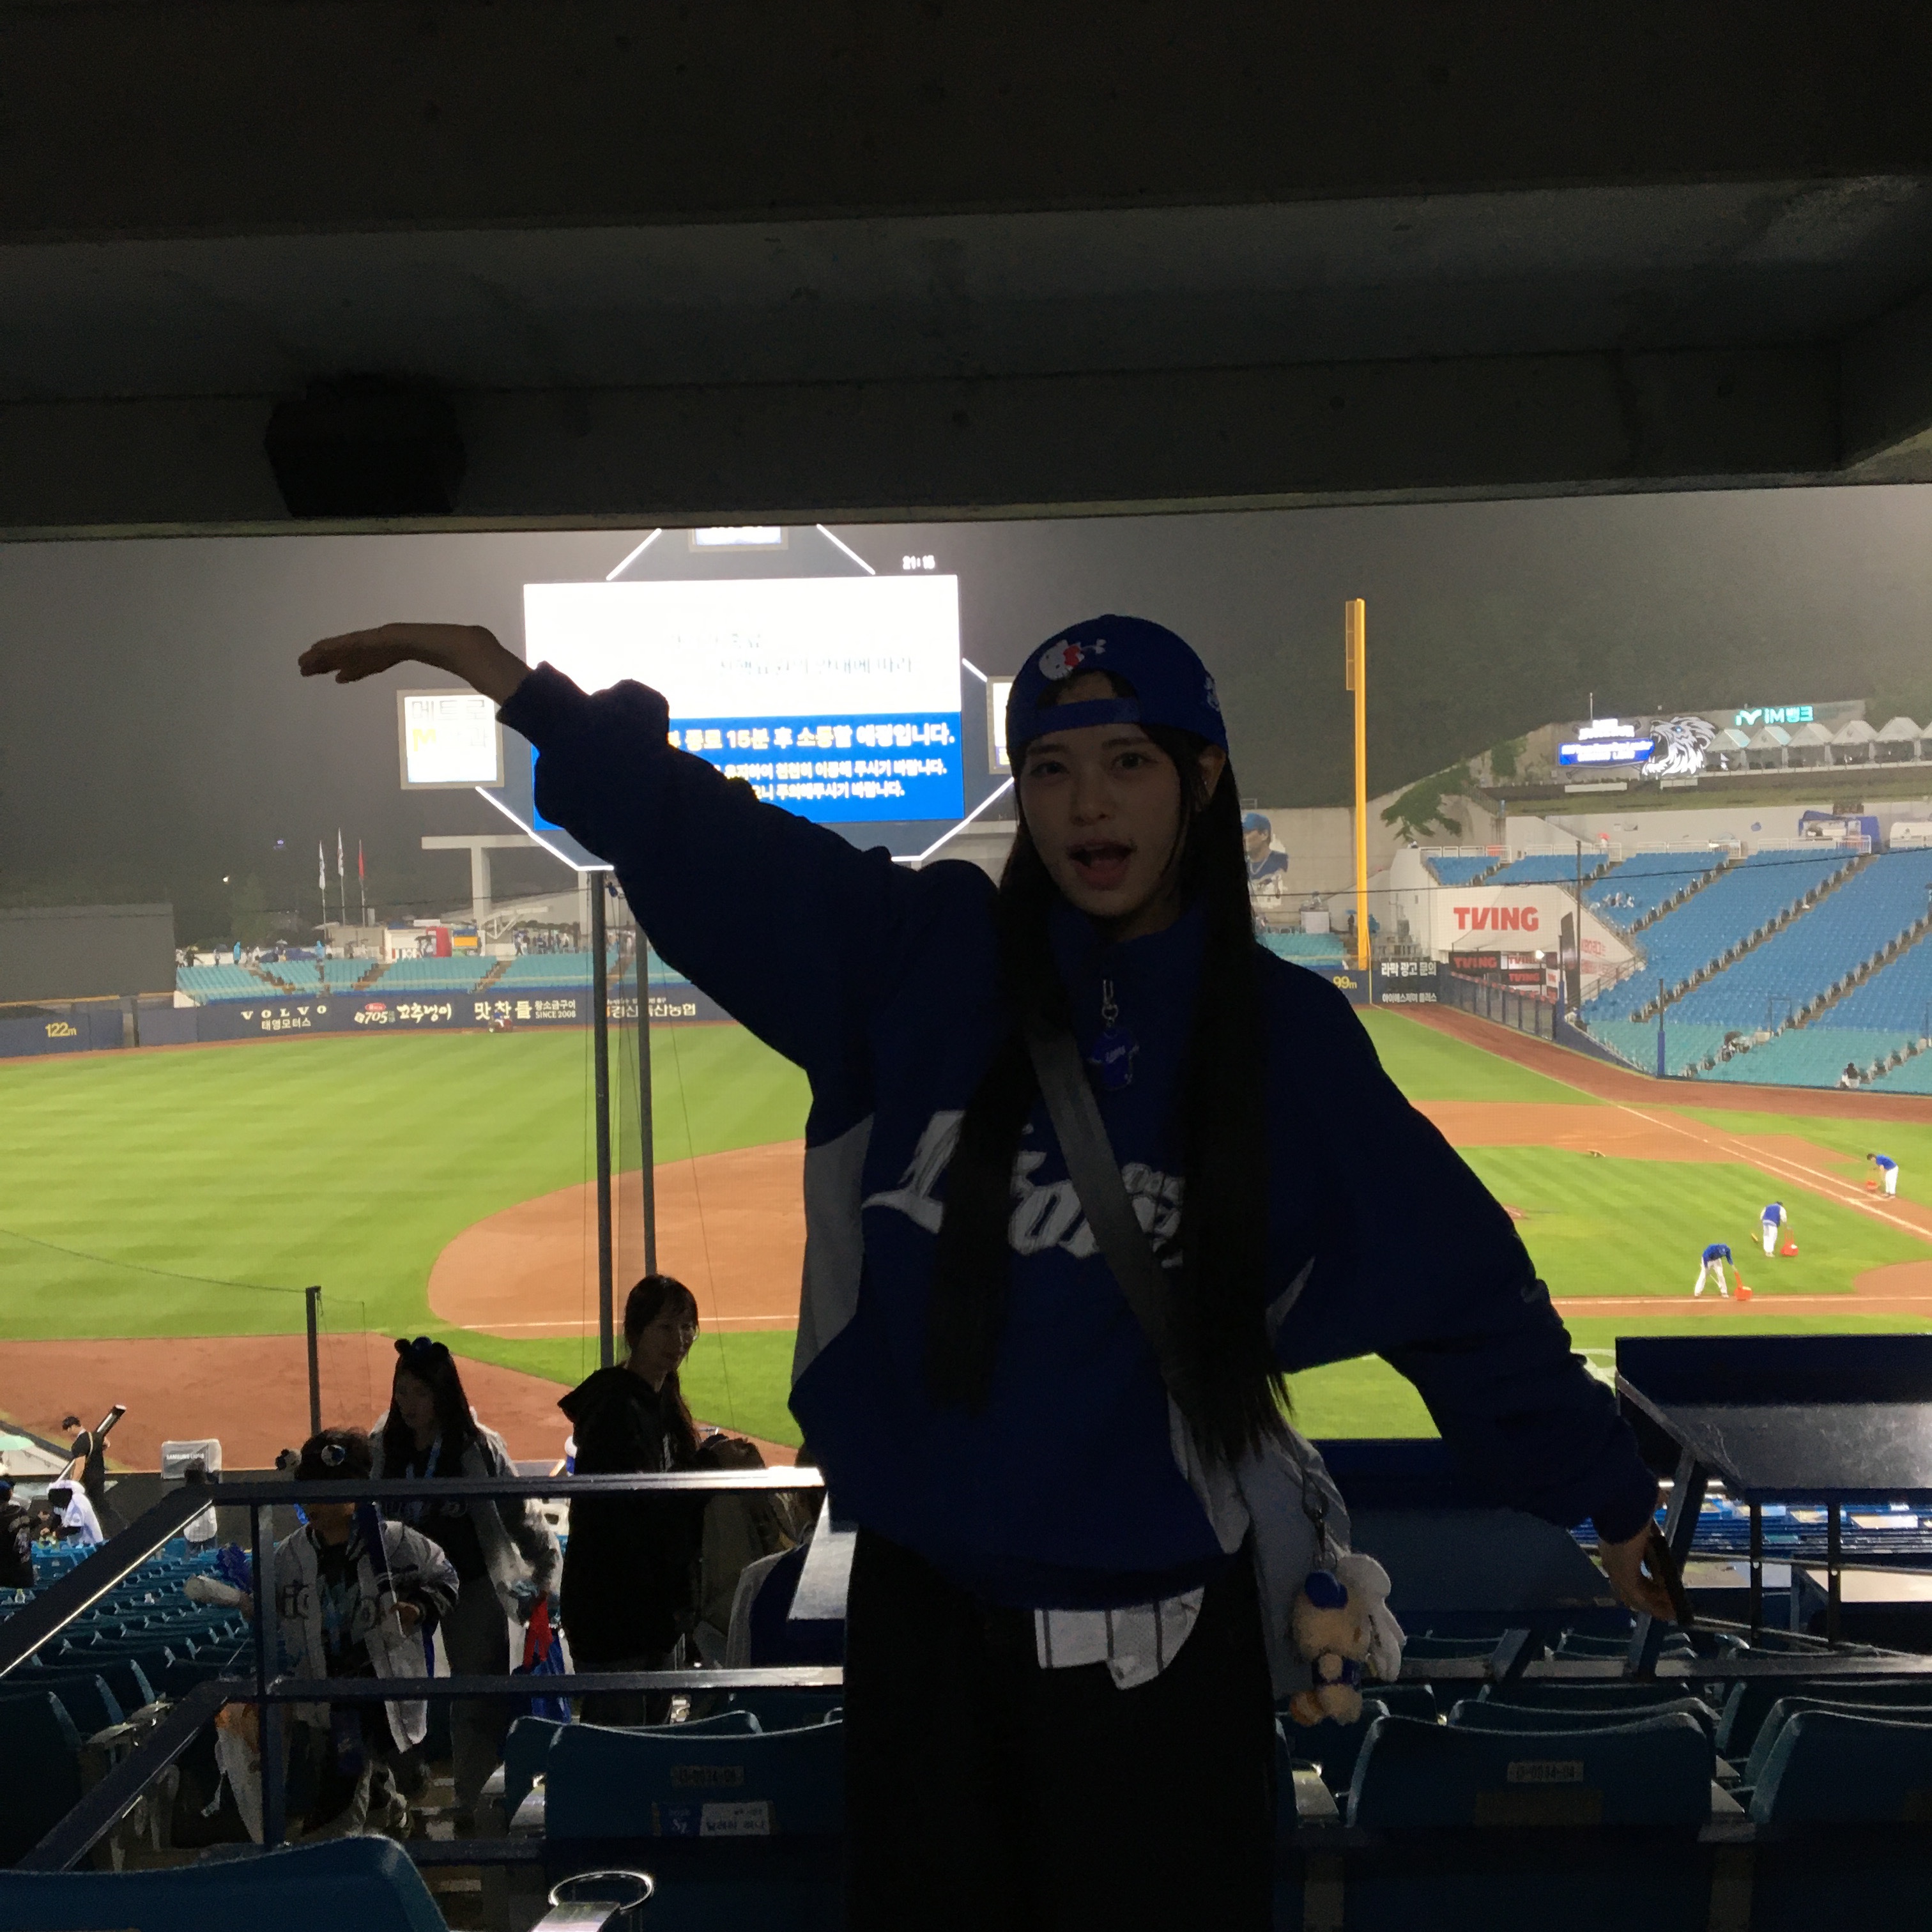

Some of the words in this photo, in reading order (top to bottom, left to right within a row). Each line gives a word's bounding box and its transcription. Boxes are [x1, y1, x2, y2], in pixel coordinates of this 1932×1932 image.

[727, 727, 769, 749] 15분
[774, 726, 792, 749] 후
[856, 723, 955, 747] 예정입니다.
[893, 758, 947, 776] 바랍니다.
[852, 780, 905, 799] 바랍니다.
[1453, 907, 1538, 931] TVING
[1400, 962, 1418, 977] 광고
[1420, 962, 1437, 976] 문의
[1453, 956, 1498, 969] TVING
[1333, 976, 1358, 990] 99m
[241, 1005, 327, 1020] VOLVO
[535, 1011, 556, 1019] SINCE
[558, 1010, 576, 1018] 2008
[45, 1022, 77, 1038] 122m
[261, 1017, 311, 1031] 태영모터스
